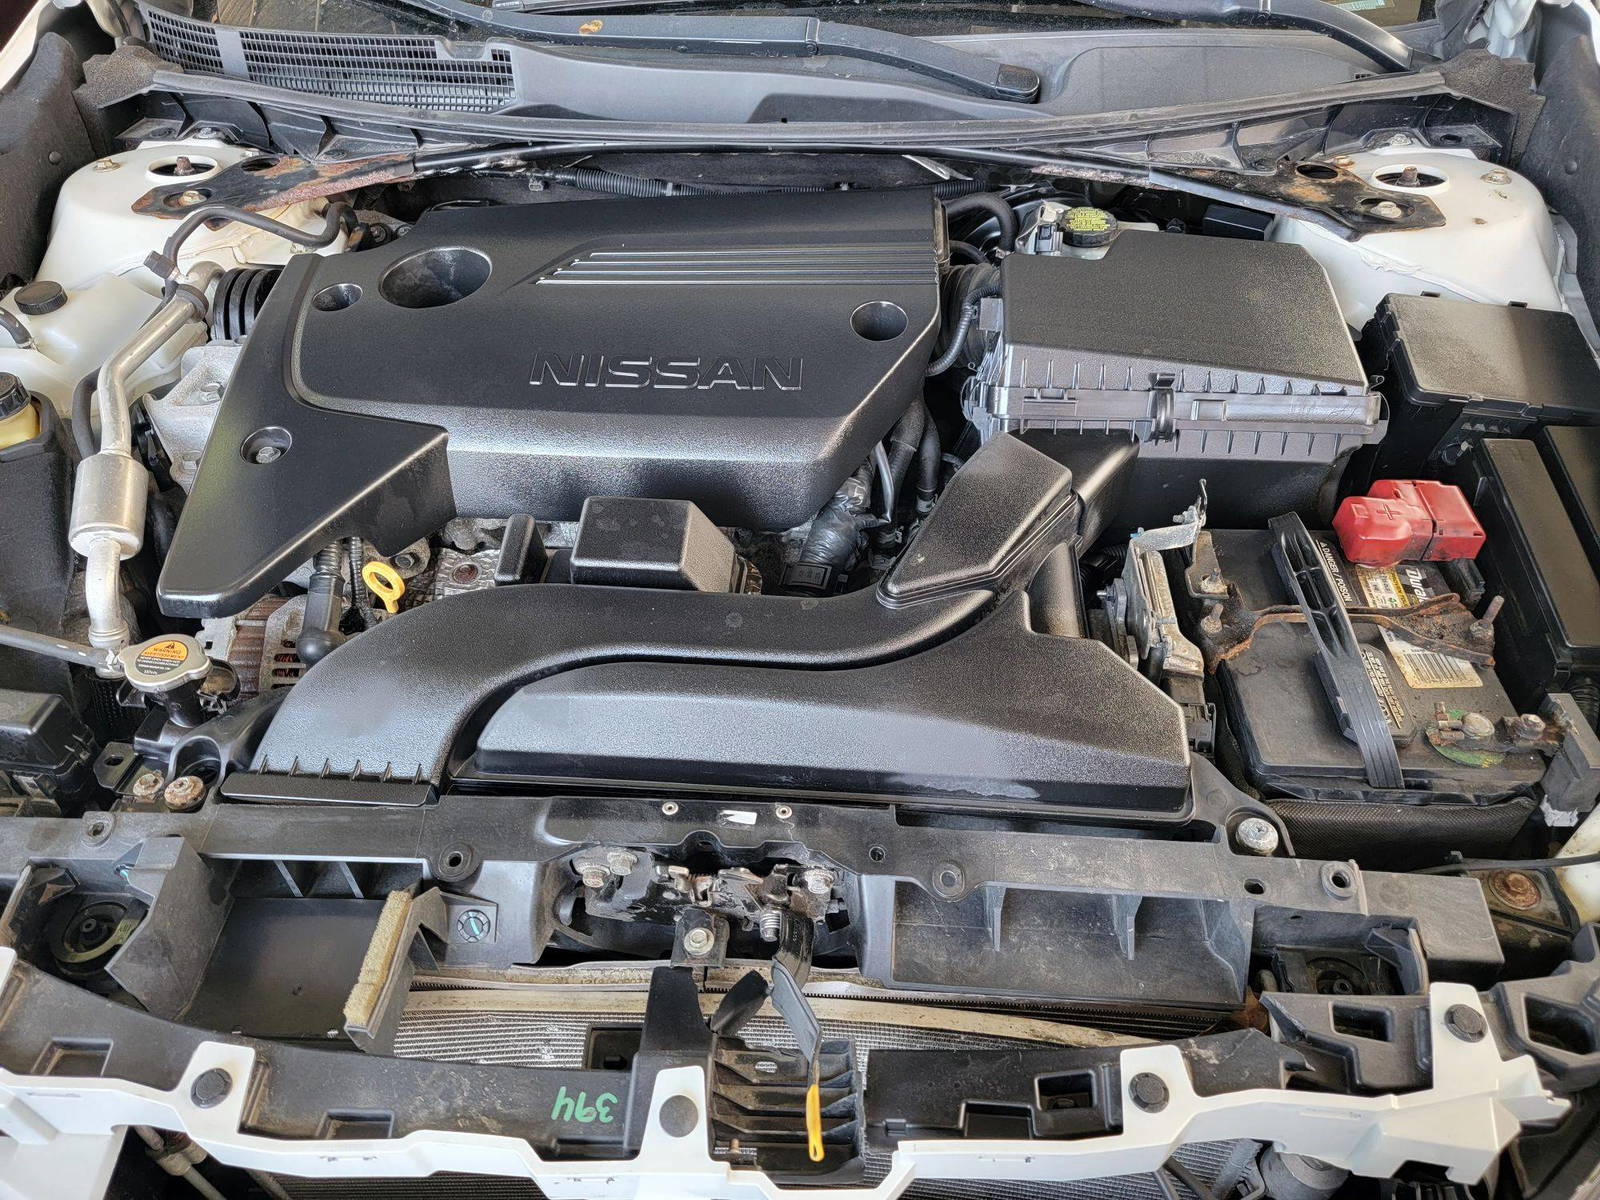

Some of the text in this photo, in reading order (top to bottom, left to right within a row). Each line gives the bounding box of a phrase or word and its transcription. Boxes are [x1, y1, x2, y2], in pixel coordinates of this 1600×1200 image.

[530, 354, 803, 391] NISSAN
[1322, 547, 1339, 572] DANGER
[1335, 578, 1353, 602] POISON
[551, 1086, 618, 1123] 394
